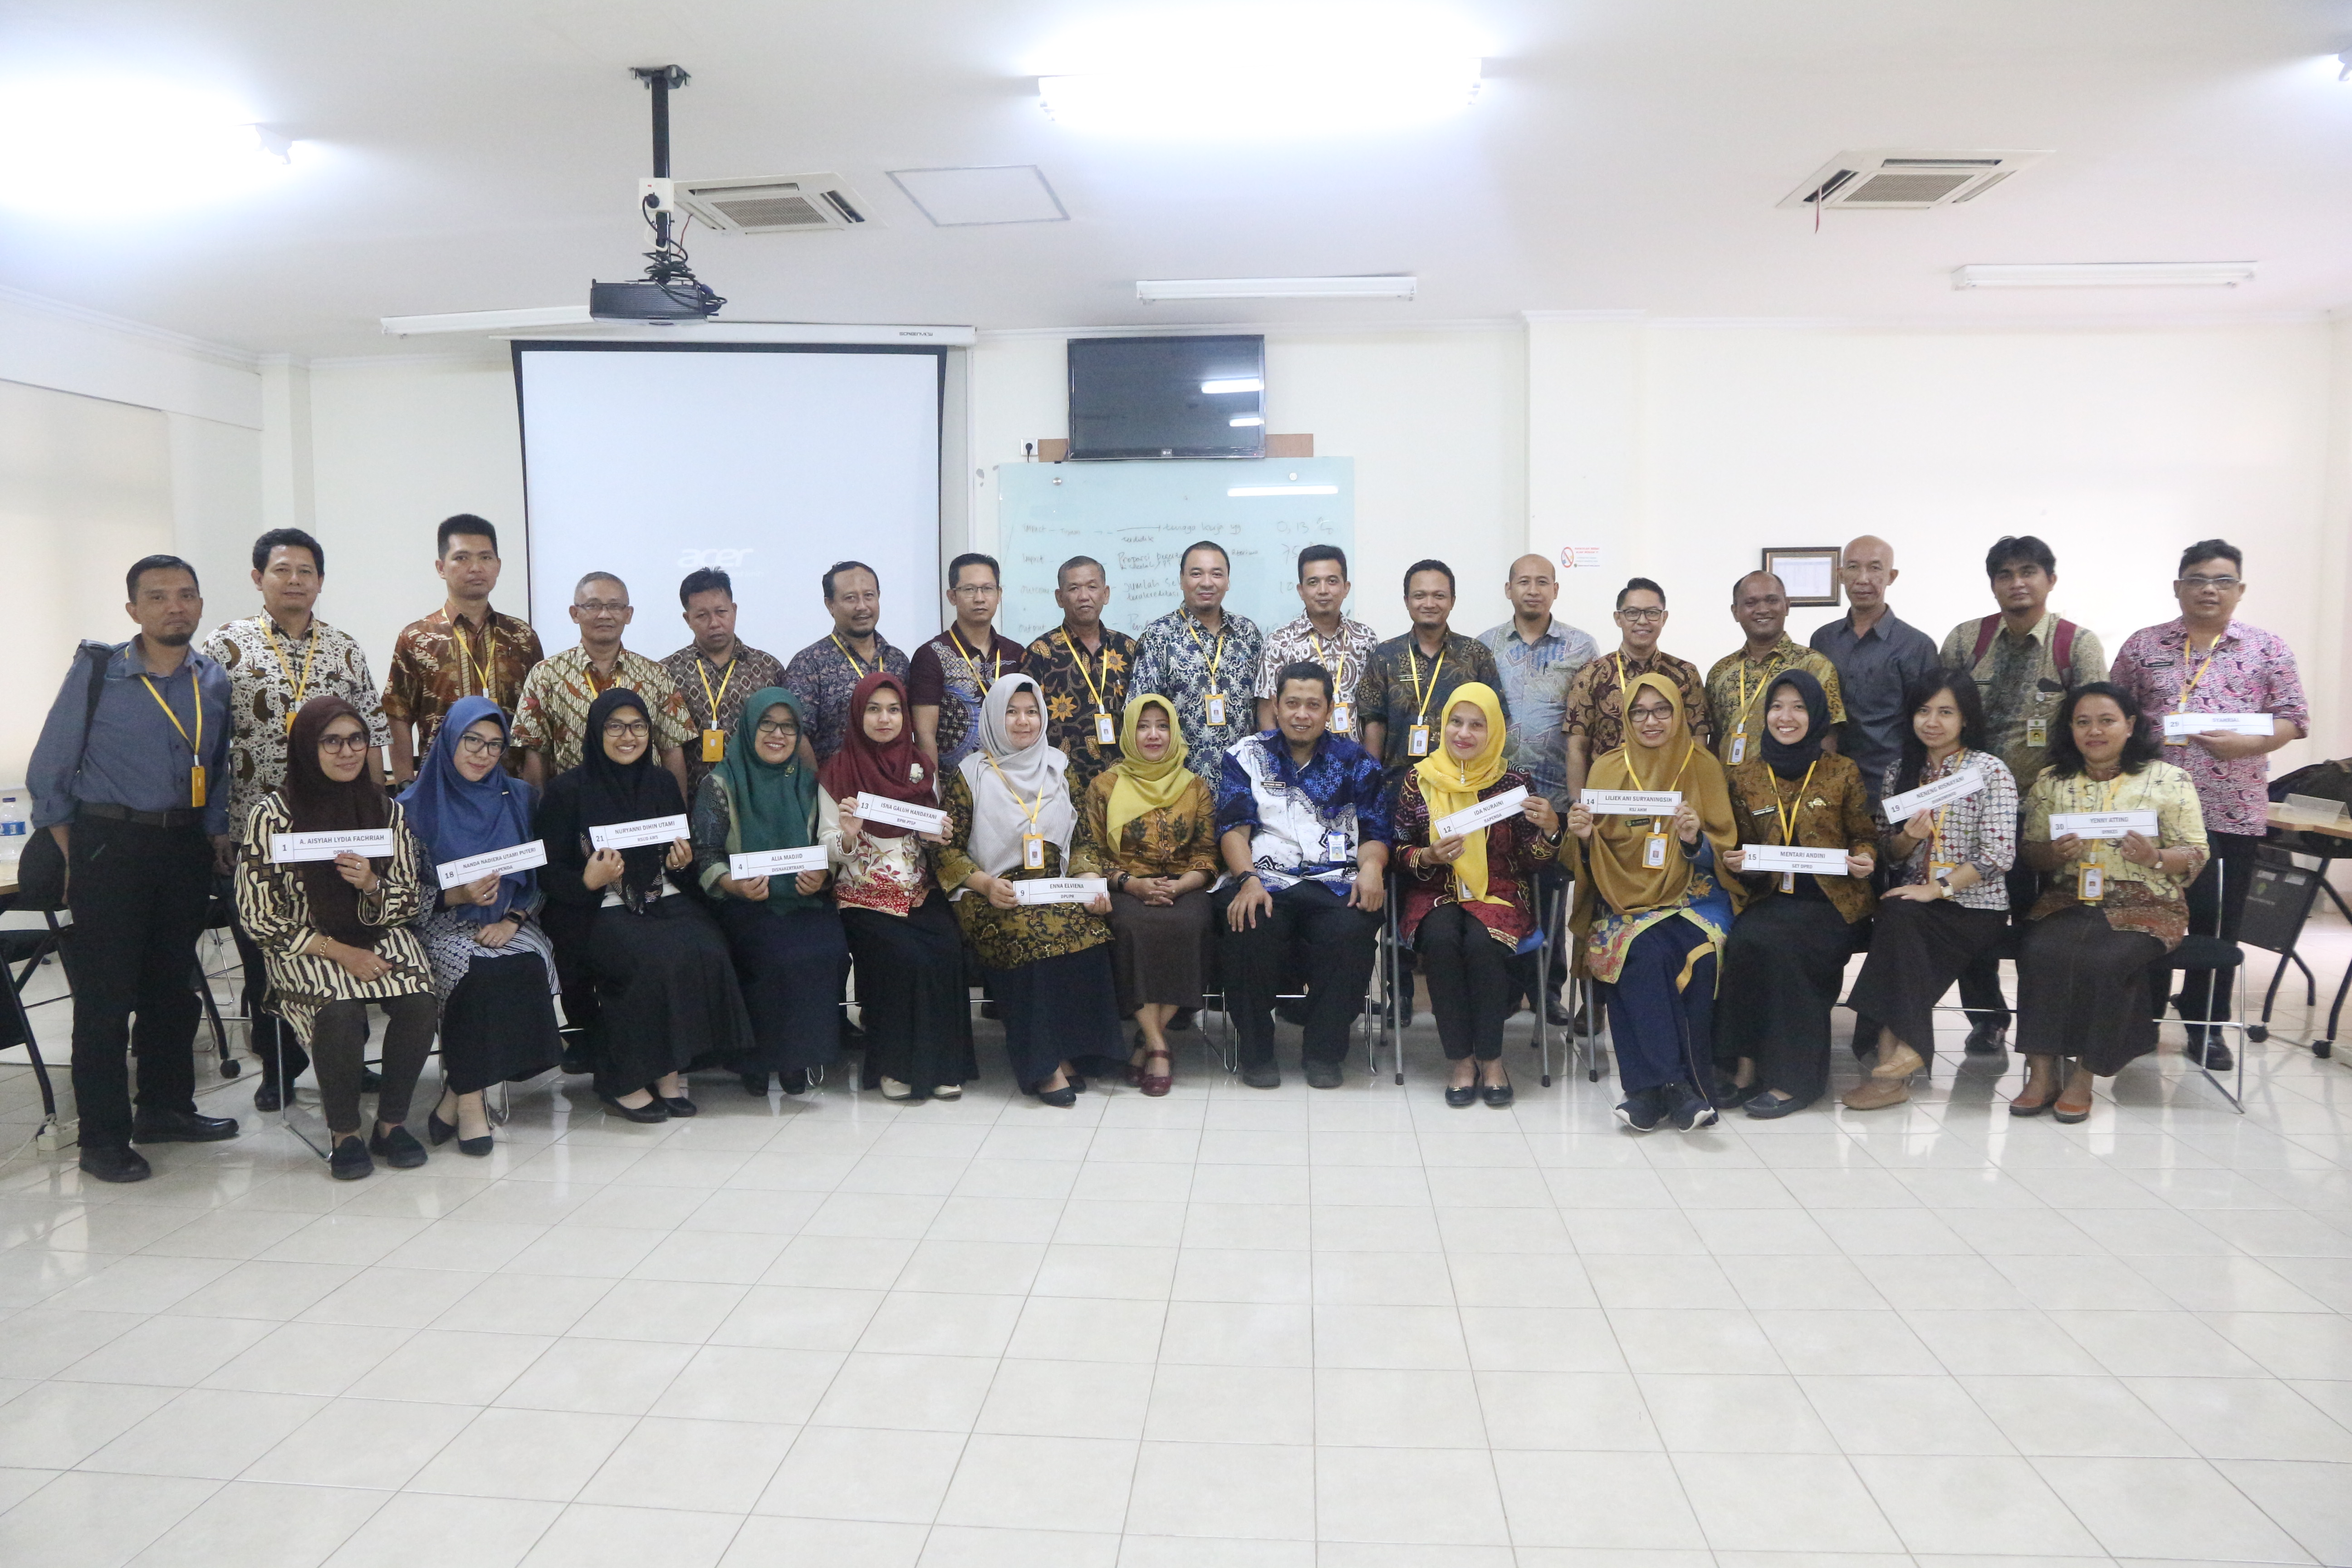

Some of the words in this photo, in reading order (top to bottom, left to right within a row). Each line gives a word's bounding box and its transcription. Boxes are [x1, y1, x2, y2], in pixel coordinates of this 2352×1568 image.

[677, 548, 754, 568] acer
[1916, 788, 1937, 799] NENENG
[1483, 800, 1504, 812] NURAINI
[1891, 805, 1901, 813] 19
[910, 809, 937, 819] HANDAYANI
[615, 826, 642, 834] NURYANNI
[481, 856, 503, 864] NADIERA
[519, 847, 536, 856] PUTERI
[445, 871, 454, 879] 18
